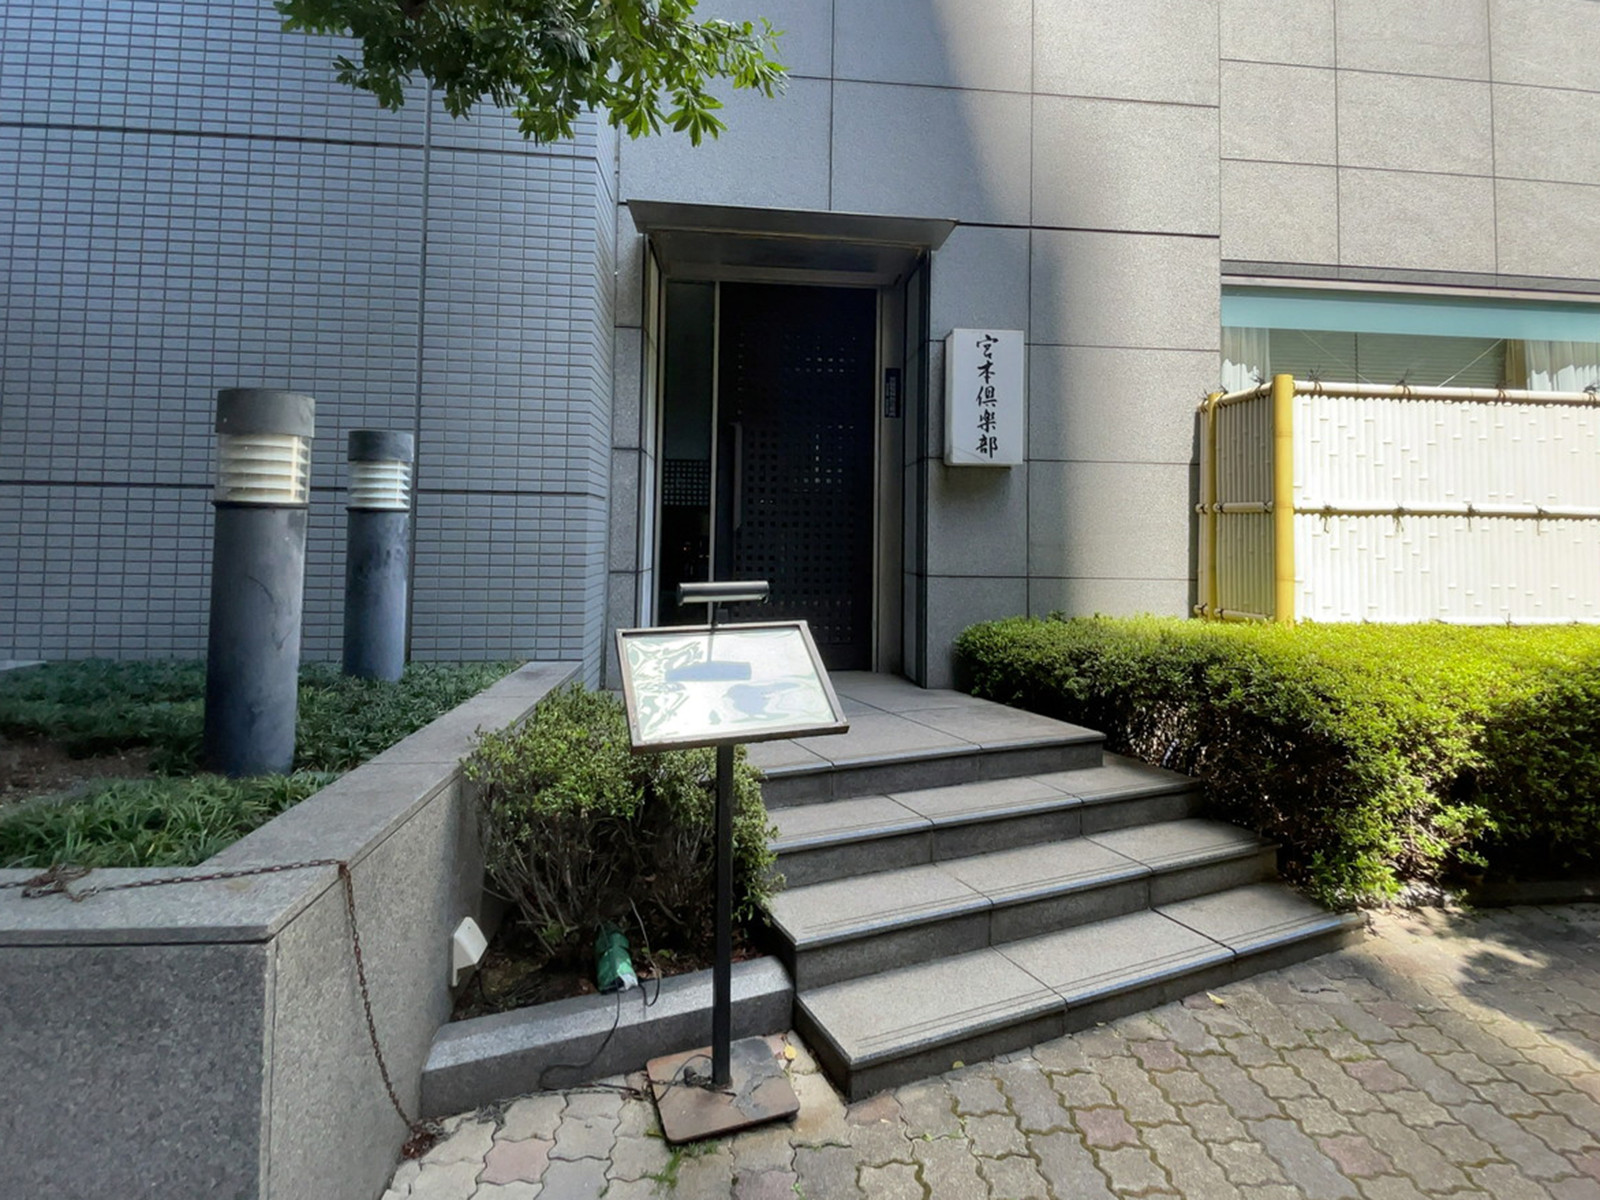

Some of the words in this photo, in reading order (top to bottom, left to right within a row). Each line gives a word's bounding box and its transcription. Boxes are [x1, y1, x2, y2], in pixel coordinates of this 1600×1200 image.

[975, 334, 999, 459] 宮本倶楽部
